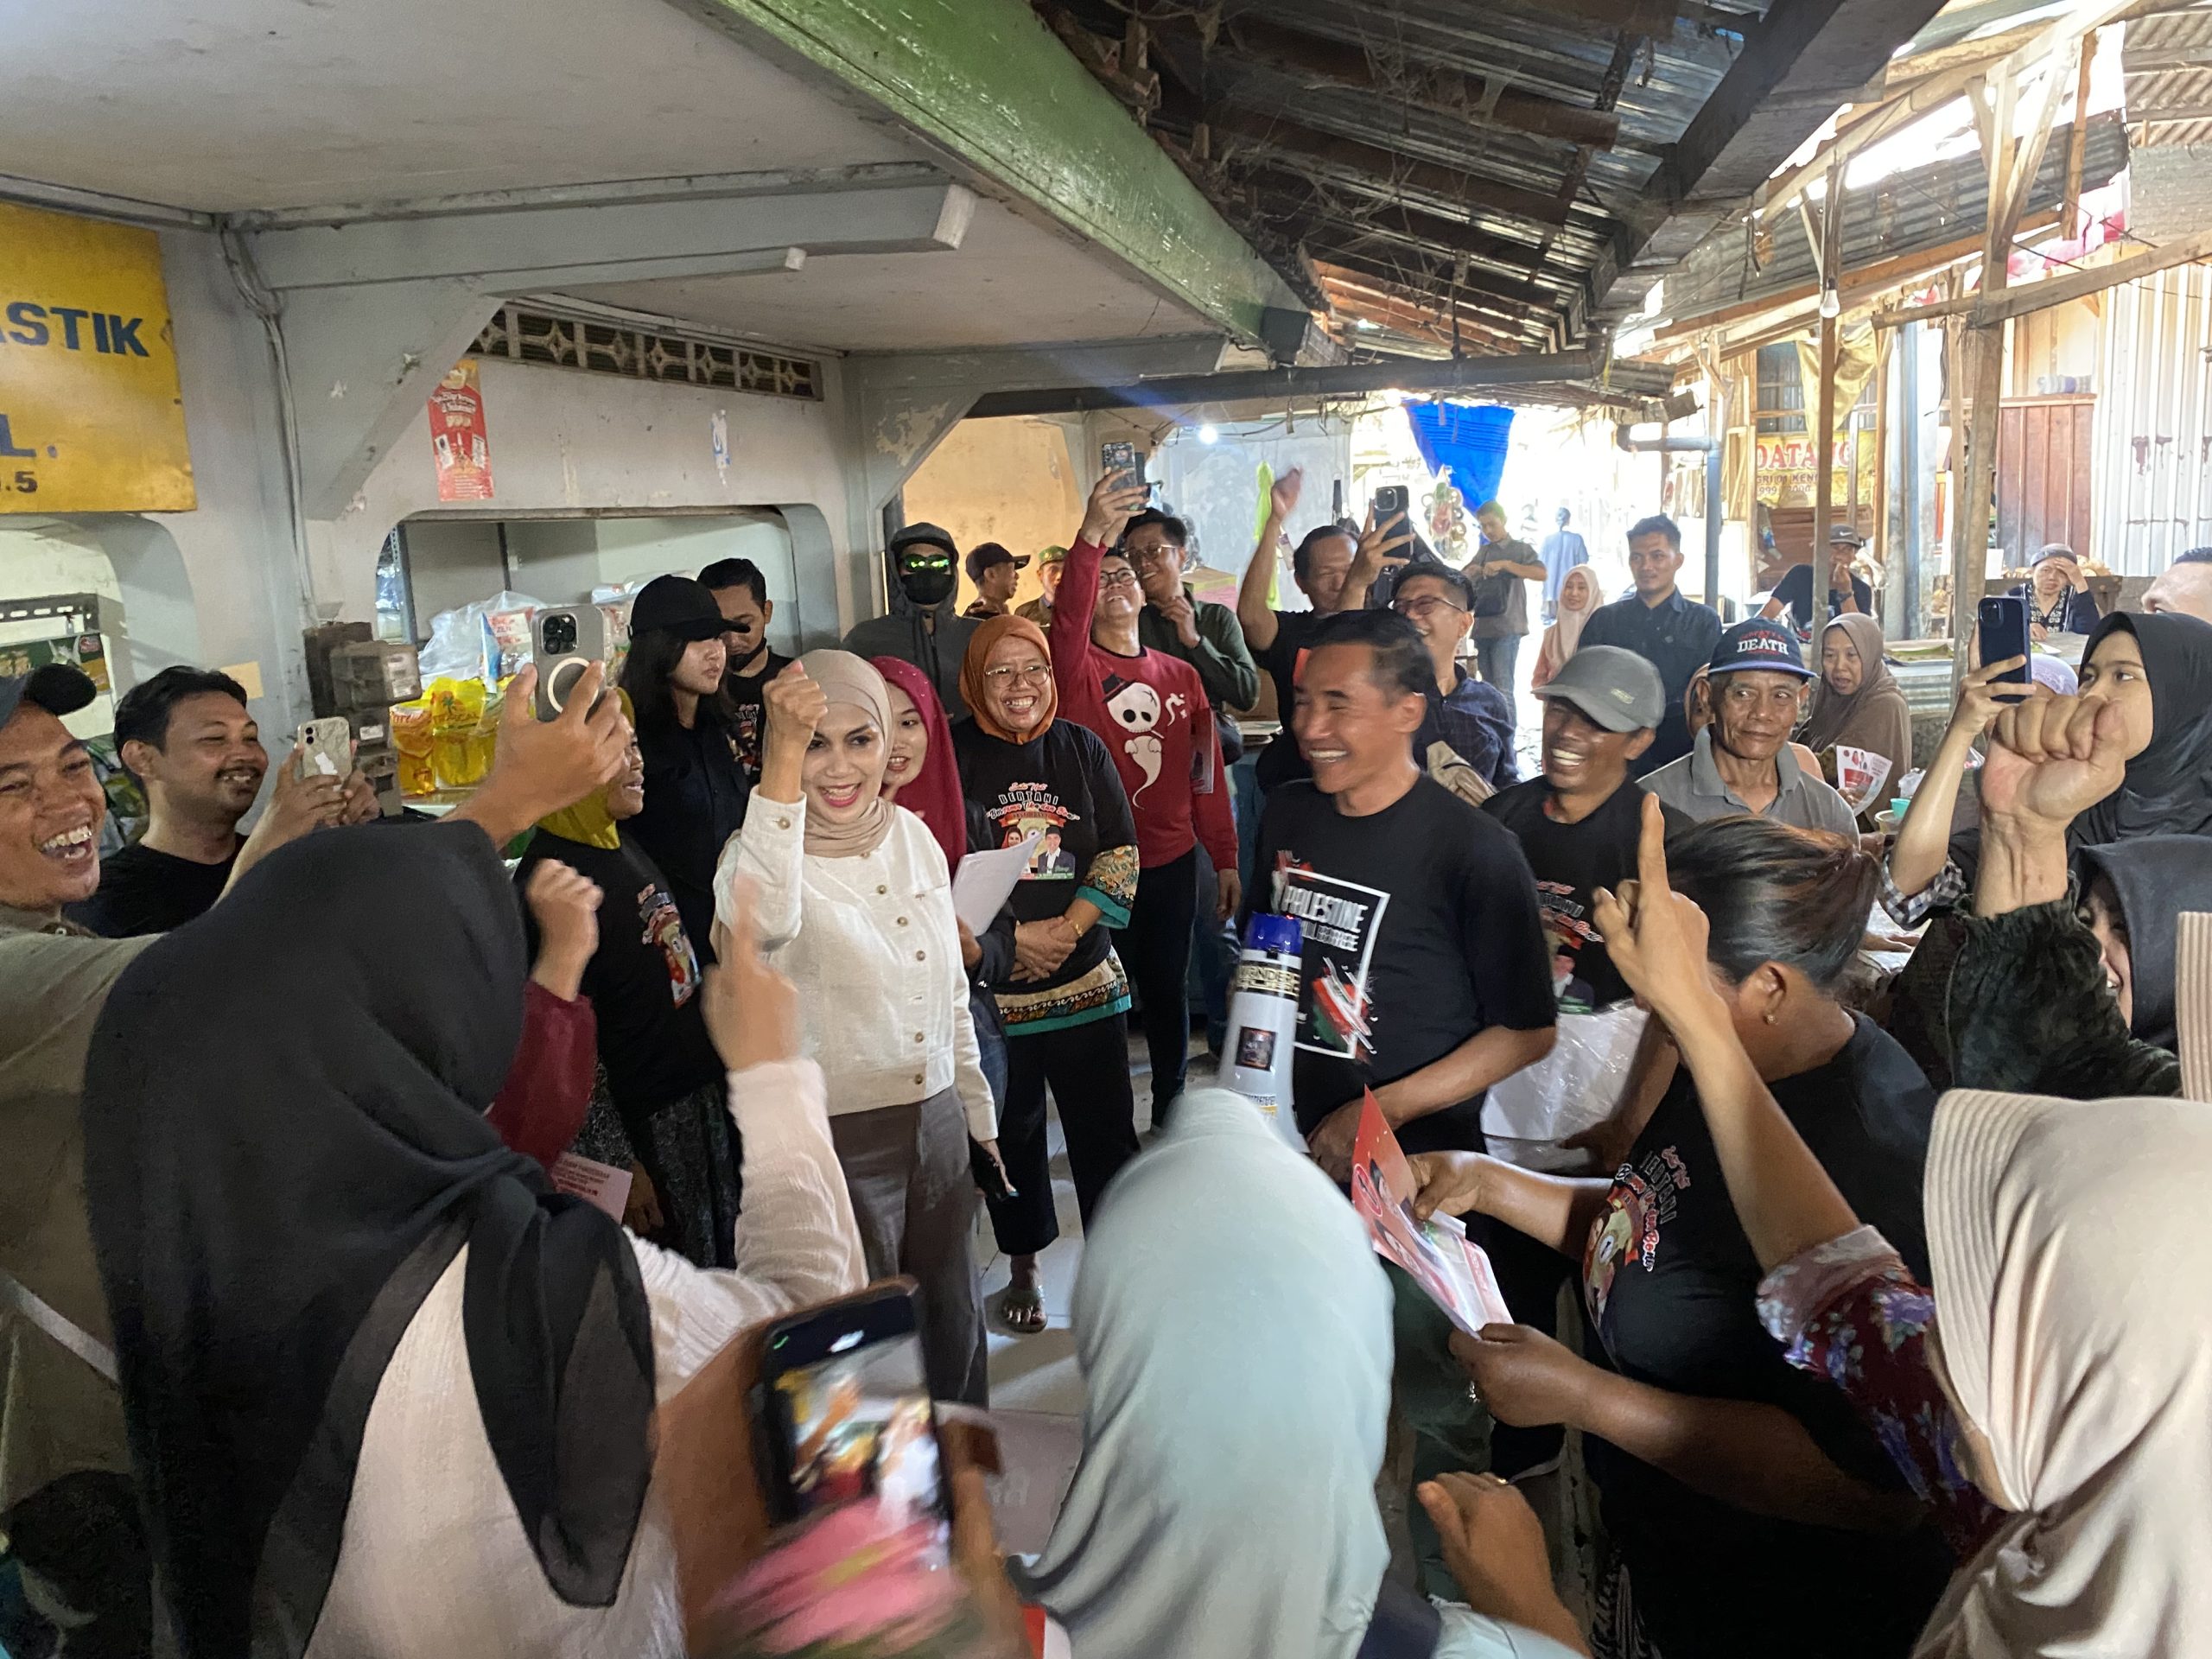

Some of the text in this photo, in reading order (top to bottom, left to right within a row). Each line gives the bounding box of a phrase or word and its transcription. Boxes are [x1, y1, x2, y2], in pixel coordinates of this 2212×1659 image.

[0, 302, 150, 357] STIK
[1737, 638, 1789, 655] DEATH
[998, 791, 1059, 806] BERTANI
[1281, 885, 1369, 934] PALESTINE
